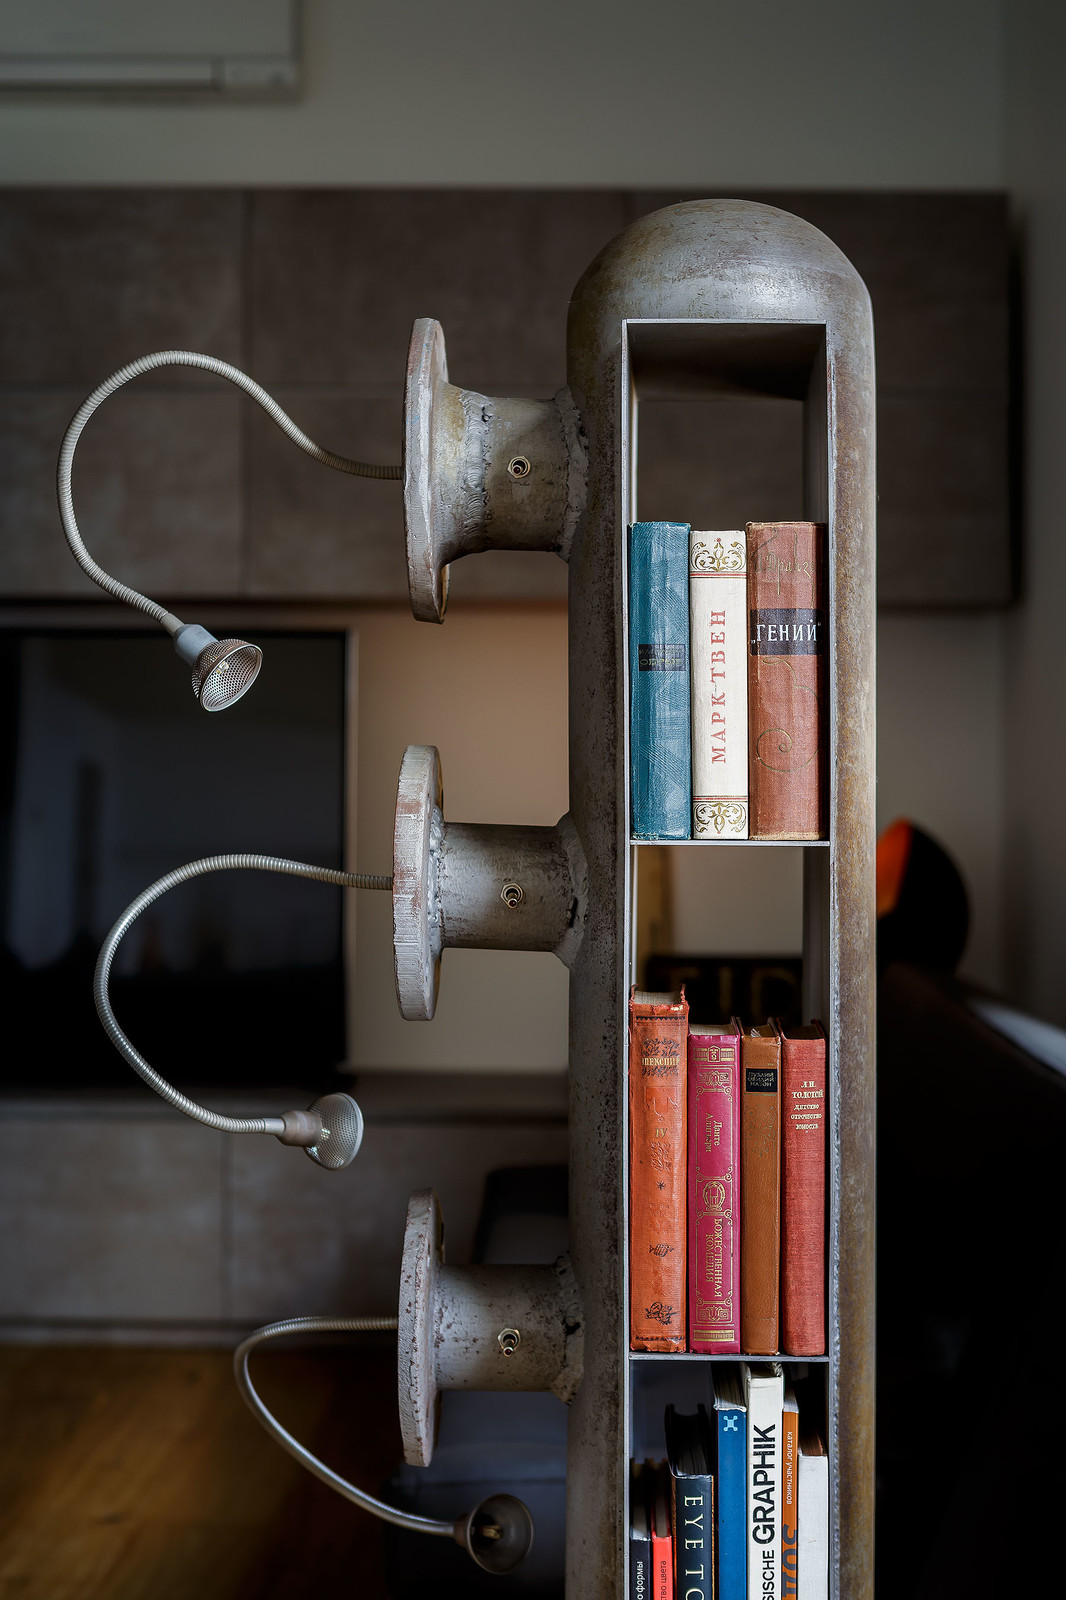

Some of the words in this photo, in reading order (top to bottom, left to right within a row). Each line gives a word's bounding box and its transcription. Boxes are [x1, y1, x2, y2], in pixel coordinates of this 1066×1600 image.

[710, 609, 726, 684] ТВЕН
[711, 691, 727, 764] МАРК
[654, 1128, 667, 1138] IV
[714, 1217, 723, 1297] БОЖЕСТВЕННАЯ
[752, 1424, 776, 1545] GRAPHIK
[785, 1462, 793, 1505] участников
[684, 1495, 704, 1550] EYE
[635, 1561, 646, 1593] формы
[660, 1560, 668, 1584] цвета
